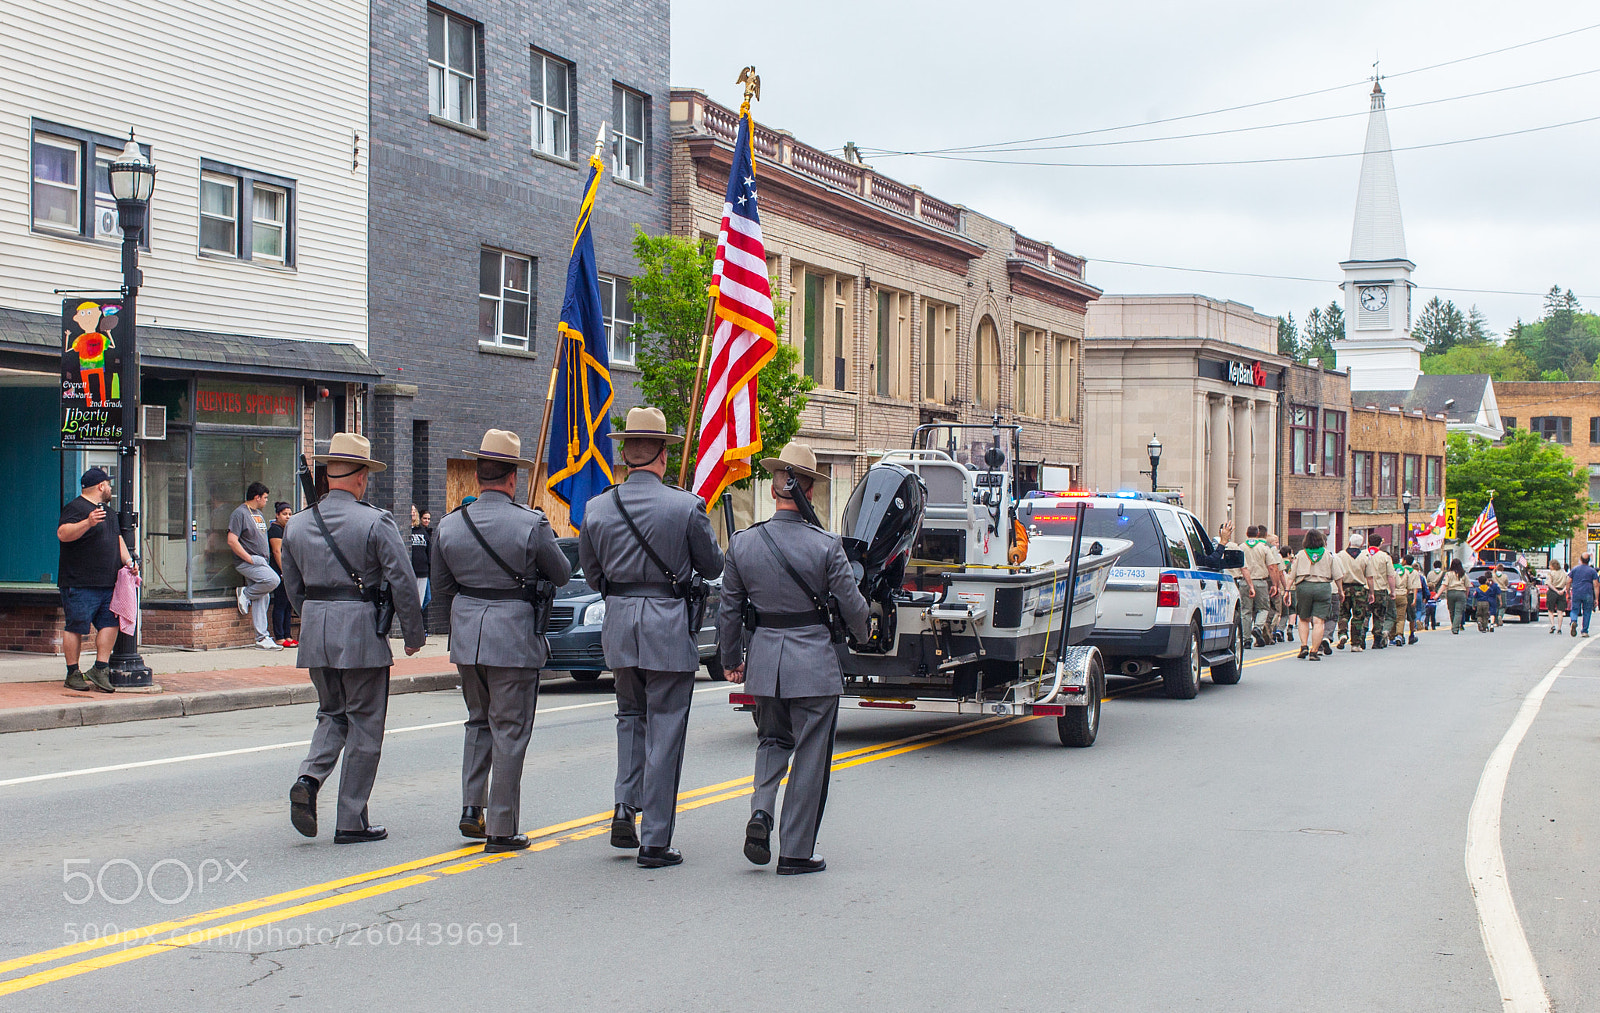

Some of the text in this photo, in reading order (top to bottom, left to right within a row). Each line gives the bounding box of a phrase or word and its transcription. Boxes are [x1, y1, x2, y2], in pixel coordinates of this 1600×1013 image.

[1229, 360, 1254, 387] KeyBank
[63, 380, 87, 389] Everett
[63, 391, 93, 399] Schwartz
[90, 400, 103, 408] 2nd
[196, 390, 296, 416] FUENTES SPECIALTY
[61, 407, 109, 433] Liberty
[78, 423, 123, 439] Artists
[1447, 507, 1456, 538] TAXI
